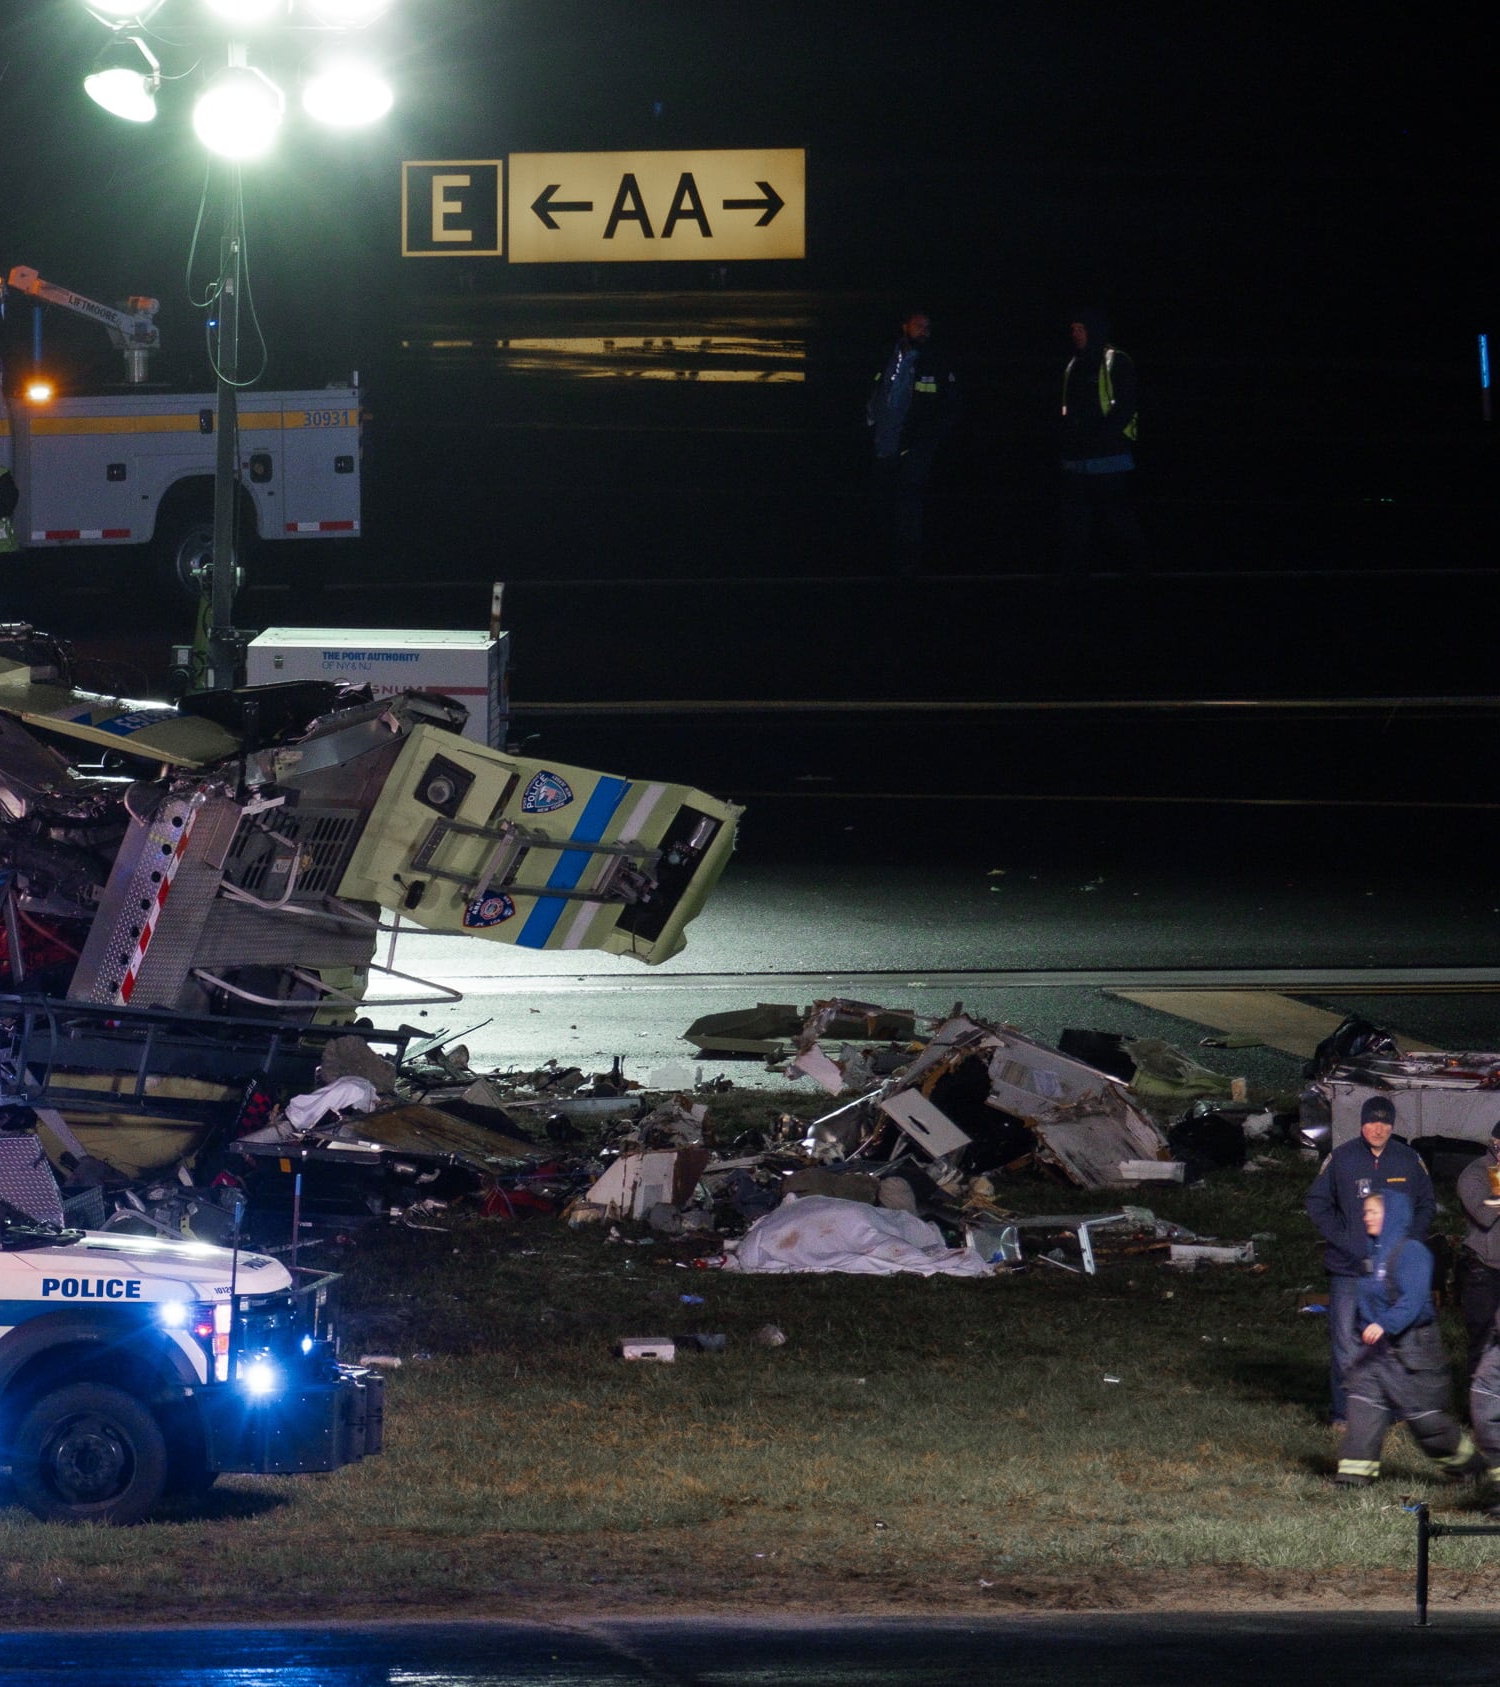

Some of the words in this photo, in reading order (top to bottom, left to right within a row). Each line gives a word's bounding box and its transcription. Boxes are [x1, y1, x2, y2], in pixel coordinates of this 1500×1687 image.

[432, 174, 472, 242] E
[602, 172, 713, 239] AA
[68, 295, 117, 321] LIFTMOORE
[304, 411, 349, 426] 30931
[322, 651, 340, 660] THE
[342, 652, 366, 660] PORT
[367, 652, 420, 662] AUTHORITY
[322, 661, 334, 670] OF
[359, 662, 372, 670] NJ
[526, 774, 549, 809] POLICE
[42, 1278, 141, 1298] POLICE
